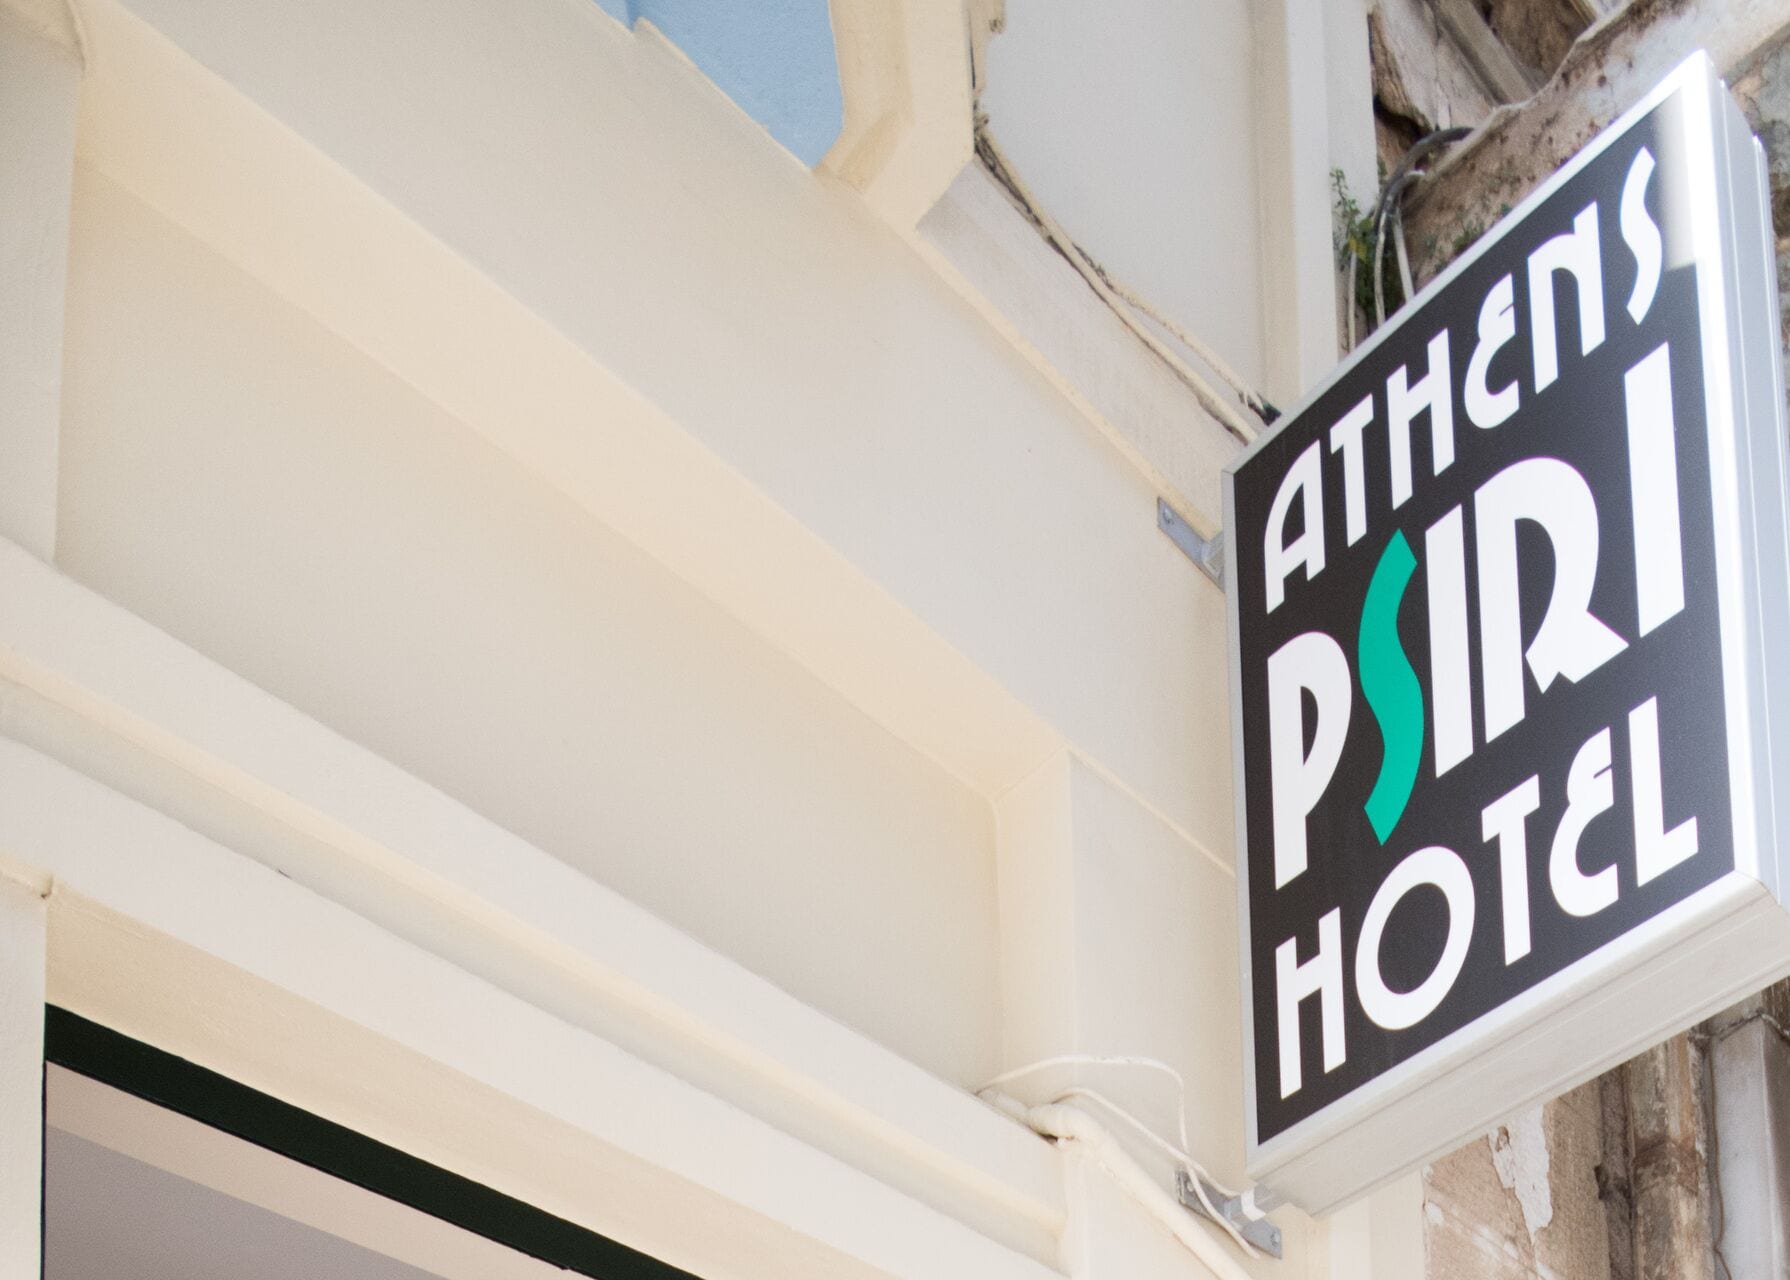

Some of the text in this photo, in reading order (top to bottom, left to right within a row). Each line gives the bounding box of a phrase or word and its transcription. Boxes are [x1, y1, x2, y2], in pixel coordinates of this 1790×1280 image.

[1264, 146, 1662, 614] ATHENS
[1267, 341, 1685, 891] PSIRI
[1275, 696, 1699, 1099] HOTEL
